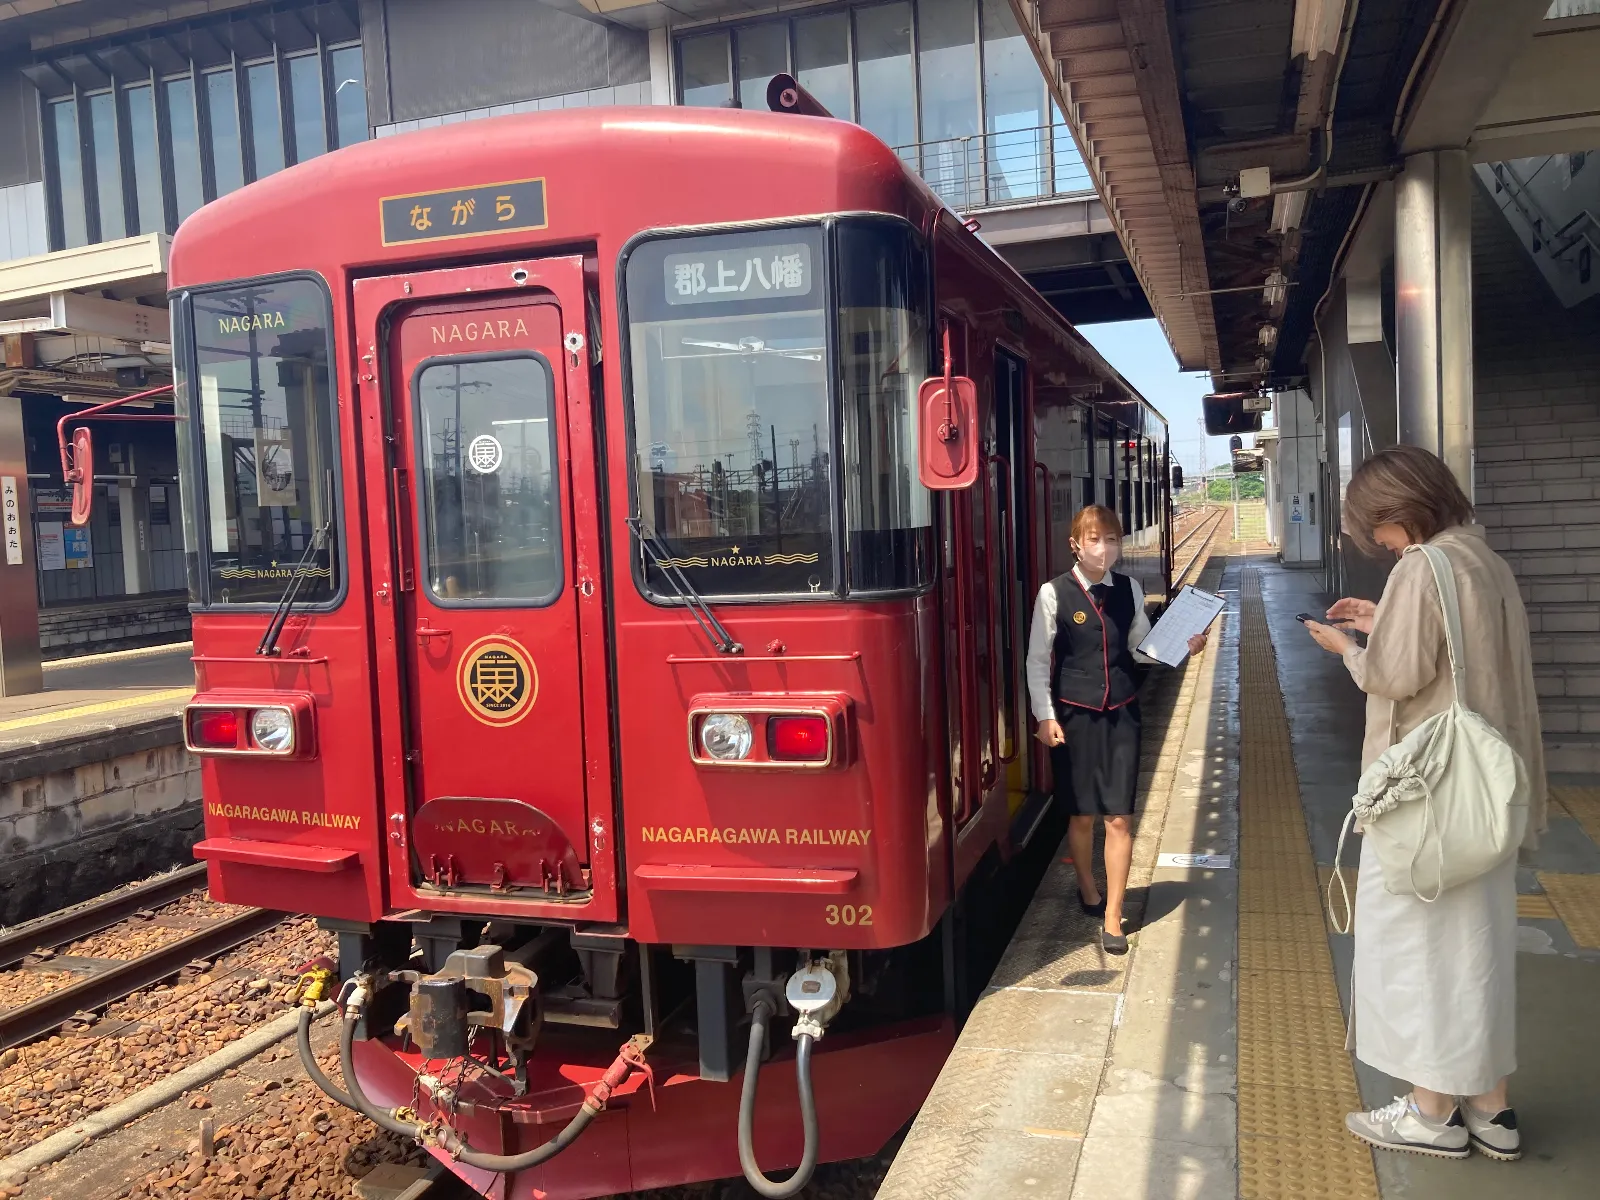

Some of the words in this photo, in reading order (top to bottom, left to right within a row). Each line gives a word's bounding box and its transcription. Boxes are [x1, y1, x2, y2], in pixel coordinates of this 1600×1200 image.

[410, 195, 516, 231] ながら
[674, 253, 803, 296] 郡上八幡
[218, 311, 285, 334] NAGARA
[431, 319, 529, 344] NAGARA
[5, 487, 18, 548] みのおおた
[711, 555, 761, 566] NAGARA
[257, 569, 292, 578] NAGARA
[208, 801, 299, 824] NAGARAGAWA
[302, 811, 361, 830] RAILWAY
[641, 826, 781, 844] NAGARAGAWA
[785, 828, 872, 846] RAILWAY
[825, 904, 873, 926] 302
